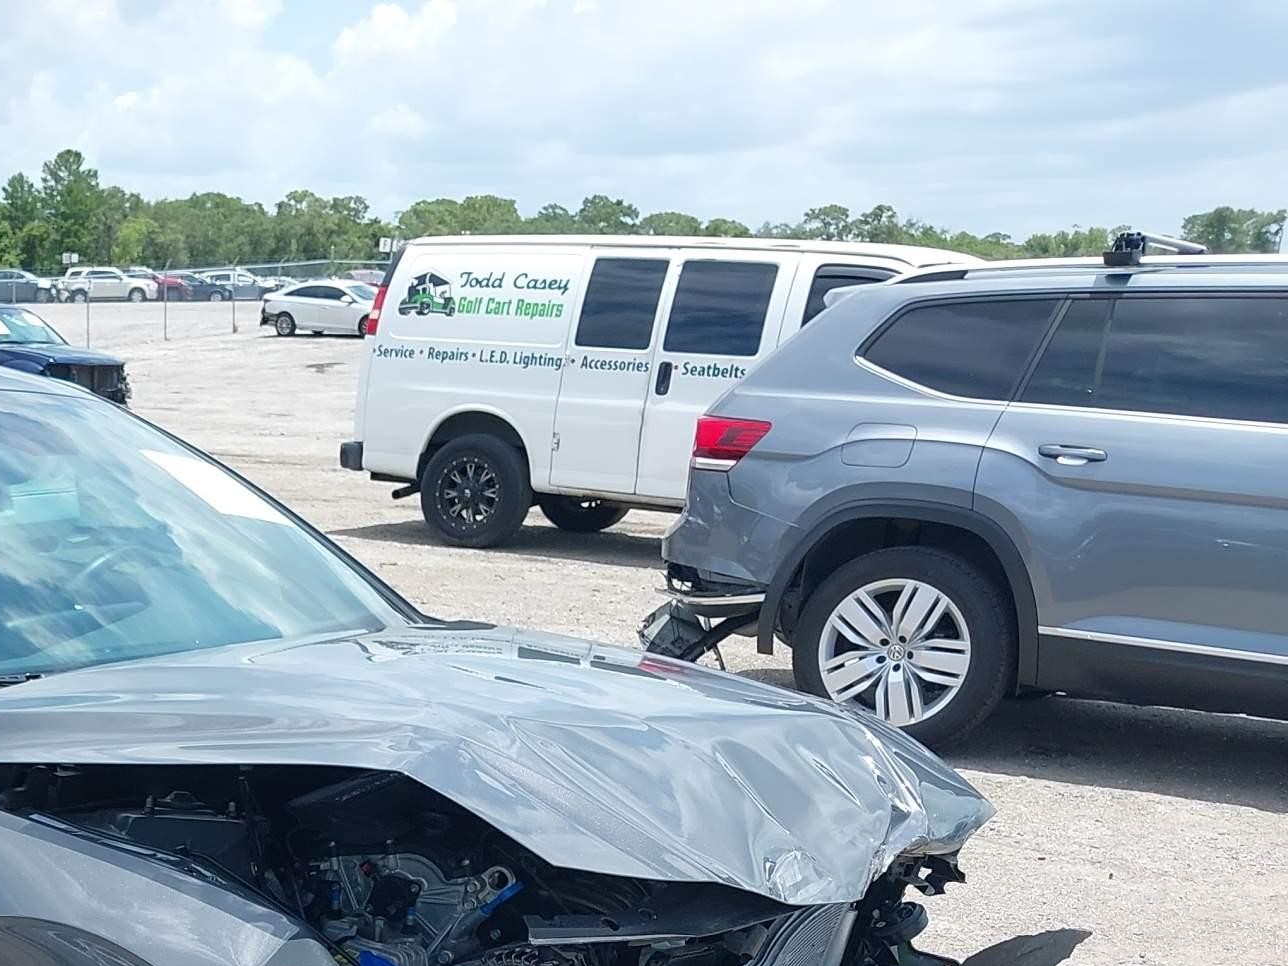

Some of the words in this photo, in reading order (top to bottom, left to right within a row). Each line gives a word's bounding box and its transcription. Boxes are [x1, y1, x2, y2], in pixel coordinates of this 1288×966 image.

[460, 271, 506, 288] Todd
[513, 273, 571, 296] Casey
[457, 296, 483, 314] Golf
[485, 297, 513, 316] Cart
[514, 298, 564, 320] Repairs
[376, 344, 415, 360] Service
[427, 346, 470, 363] Repairs
[479, 349, 511, 365] L.E.D.
[580, 355, 650, 373] Accessories
[681, 361, 747, 380] Seatbelts
